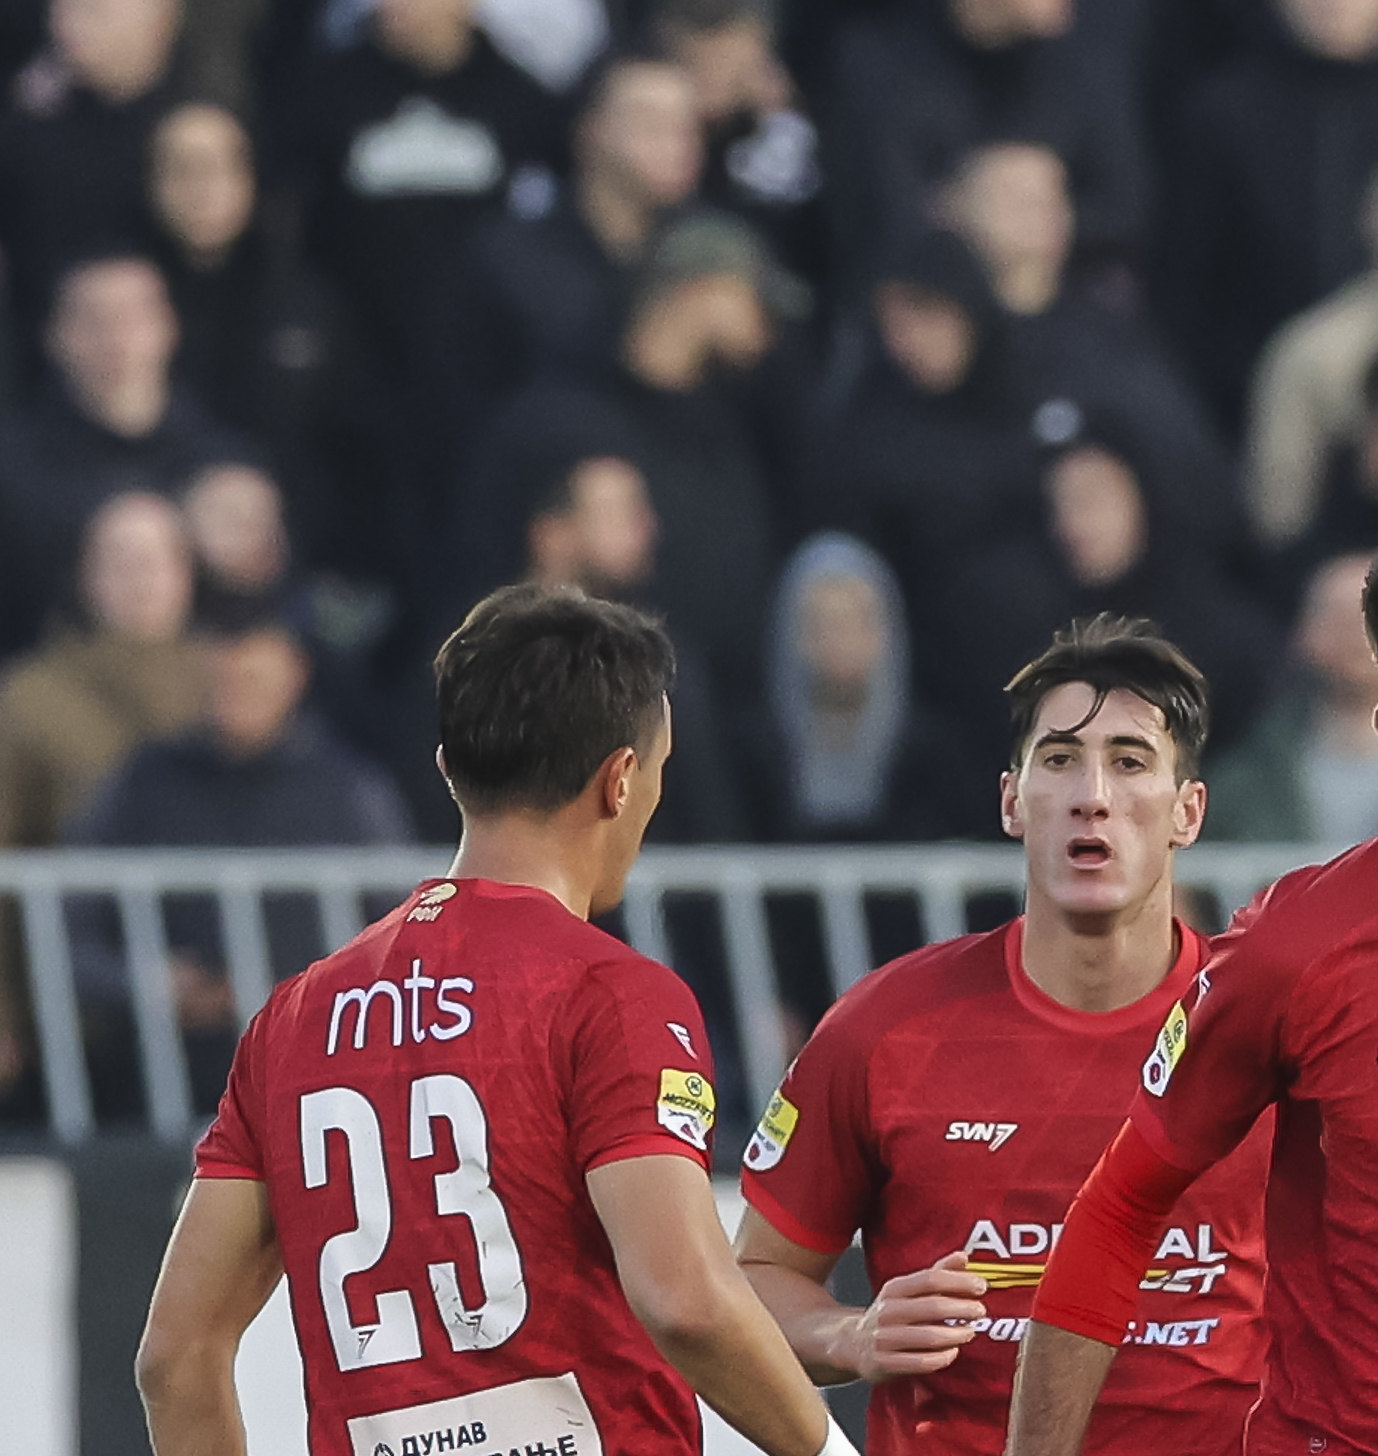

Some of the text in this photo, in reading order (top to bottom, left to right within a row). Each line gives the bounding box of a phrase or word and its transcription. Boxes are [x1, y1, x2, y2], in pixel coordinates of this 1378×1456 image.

[328, 958, 475, 1056] mts
[300, 1073, 530, 1373] 23
[963, 1220, 1228, 1264] ADAL
